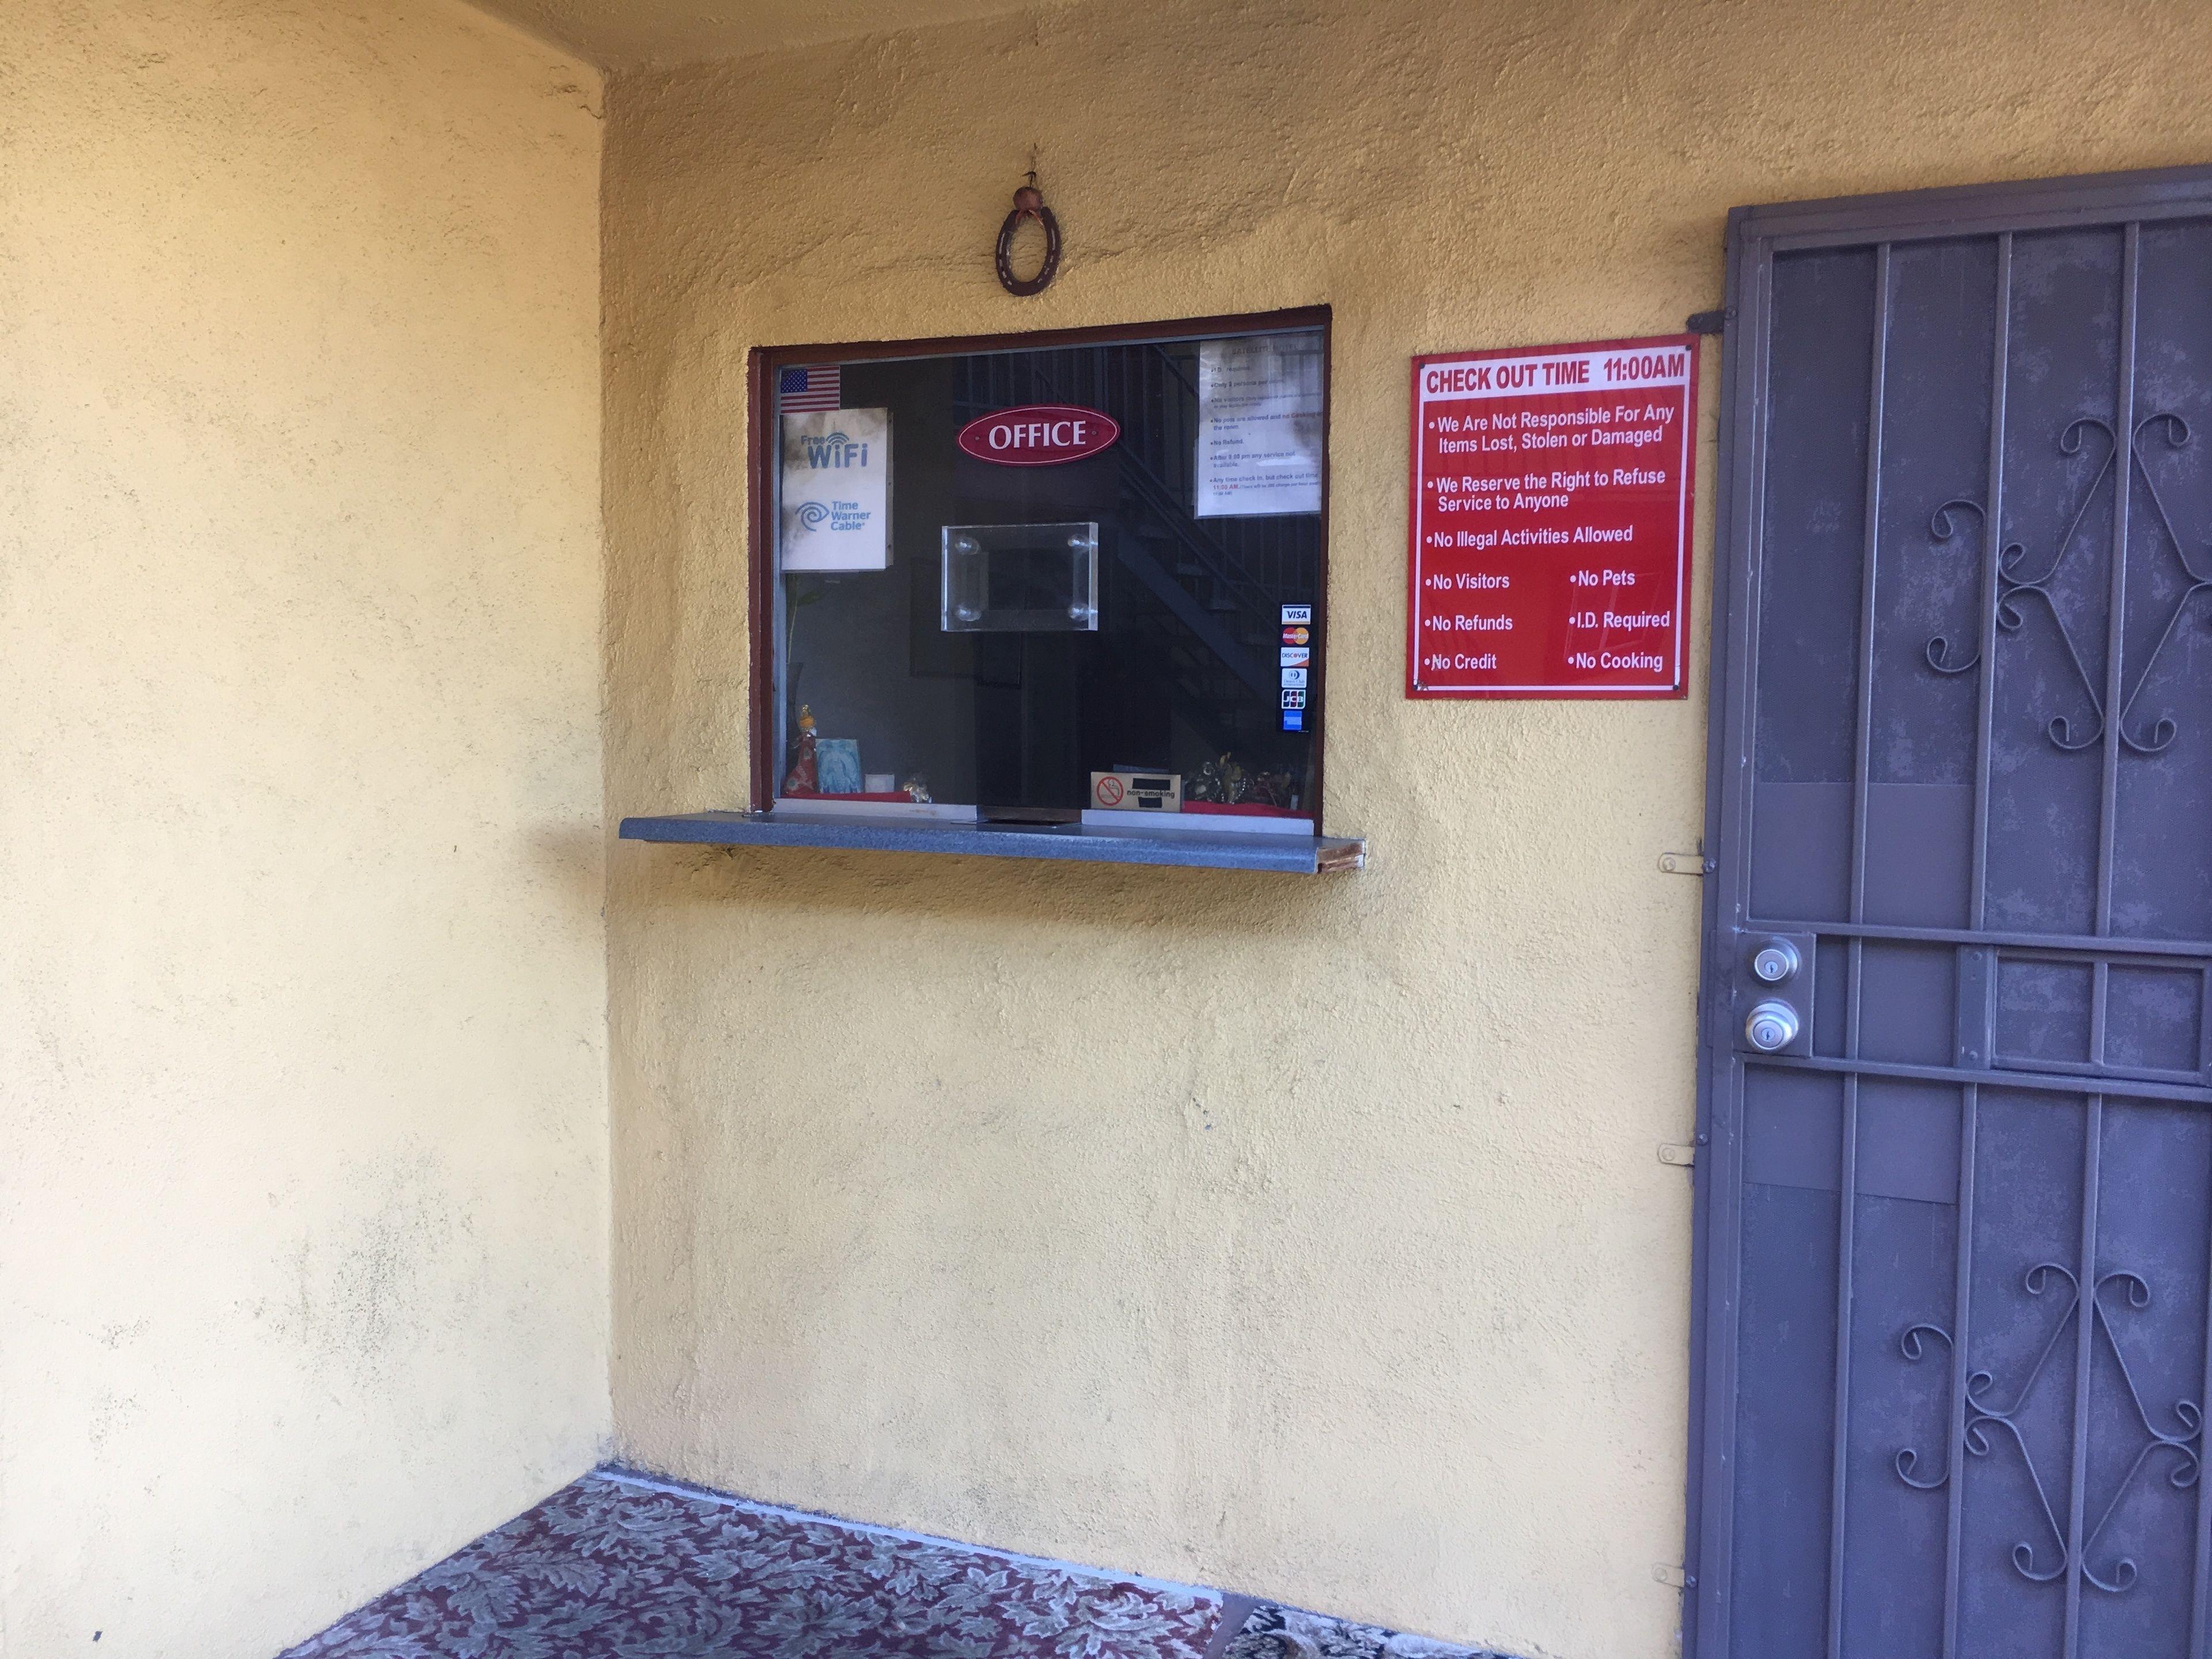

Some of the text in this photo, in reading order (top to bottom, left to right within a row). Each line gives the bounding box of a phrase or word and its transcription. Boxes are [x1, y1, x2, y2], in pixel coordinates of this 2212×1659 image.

[1426, 353, 1685, 394] CHECK OUT TIME 11:00AM
[1437, 404, 1675, 433] We Are Not Responsible For Any
[801, 435, 825, 445] Free
[988, 421, 1086, 449] OFFICE
[1439, 426, 1663, 454] Items Lost, Stolen or Damaged
[807, 443, 868, 469] WiFi
[1437, 468, 1666, 493] We Reserve the Right to Refuse
[832, 500, 858, 510] Time
[1438, 491, 1569, 513] Service to Anyone
[831, 510, 872, 520] Warner
[830, 521, 862, 531] Cable
[1434, 525, 1633, 550] No Illegal Activities Allowed
[1433, 573, 1510, 590] No Visitors
[1578, 570, 1635, 586] No Pets
[1286, 611, 1308, 619] VISA
[1433, 614, 1513, 631] No Refunds
[1577, 611, 1671, 631] I.D. Required
[1431, 653, 1497, 671] No Credit
[1576, 652, 1663, 672] No Cooking
[1127, 790, 1175, 799] non-smoking
